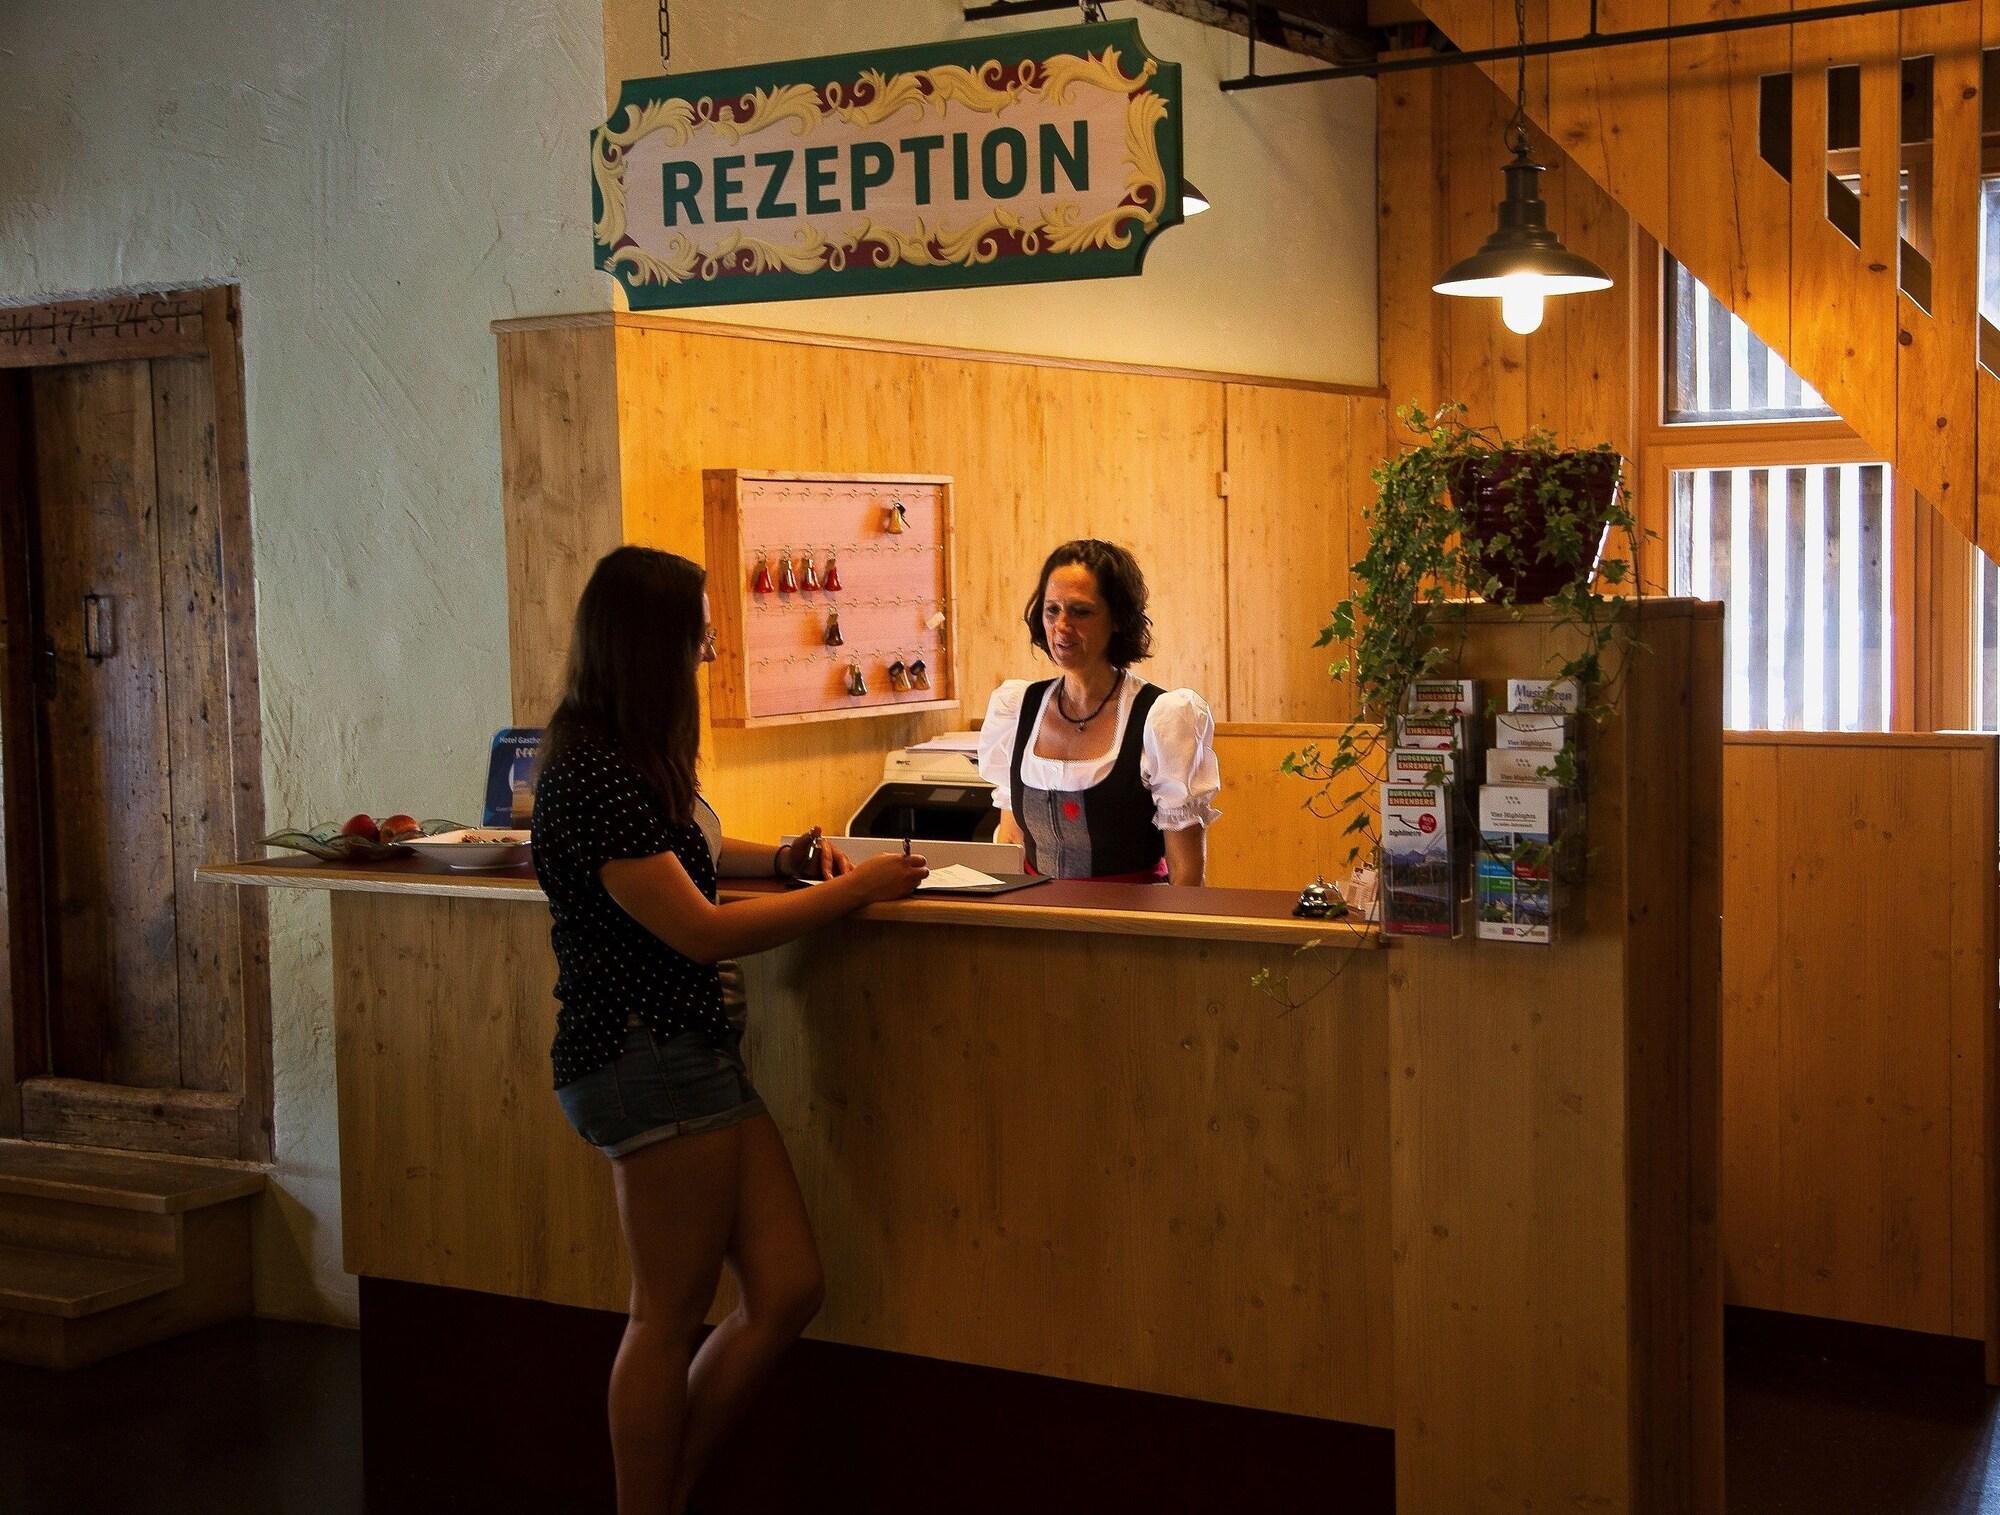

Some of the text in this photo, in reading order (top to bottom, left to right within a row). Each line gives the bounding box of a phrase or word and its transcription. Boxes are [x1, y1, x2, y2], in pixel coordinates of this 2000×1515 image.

[661, 120, 1090, 227] REZEPTION
[1398, 754, 1443, 762] BURGENWELT
[1389, 790, 1434, 798] BURGENWELT
